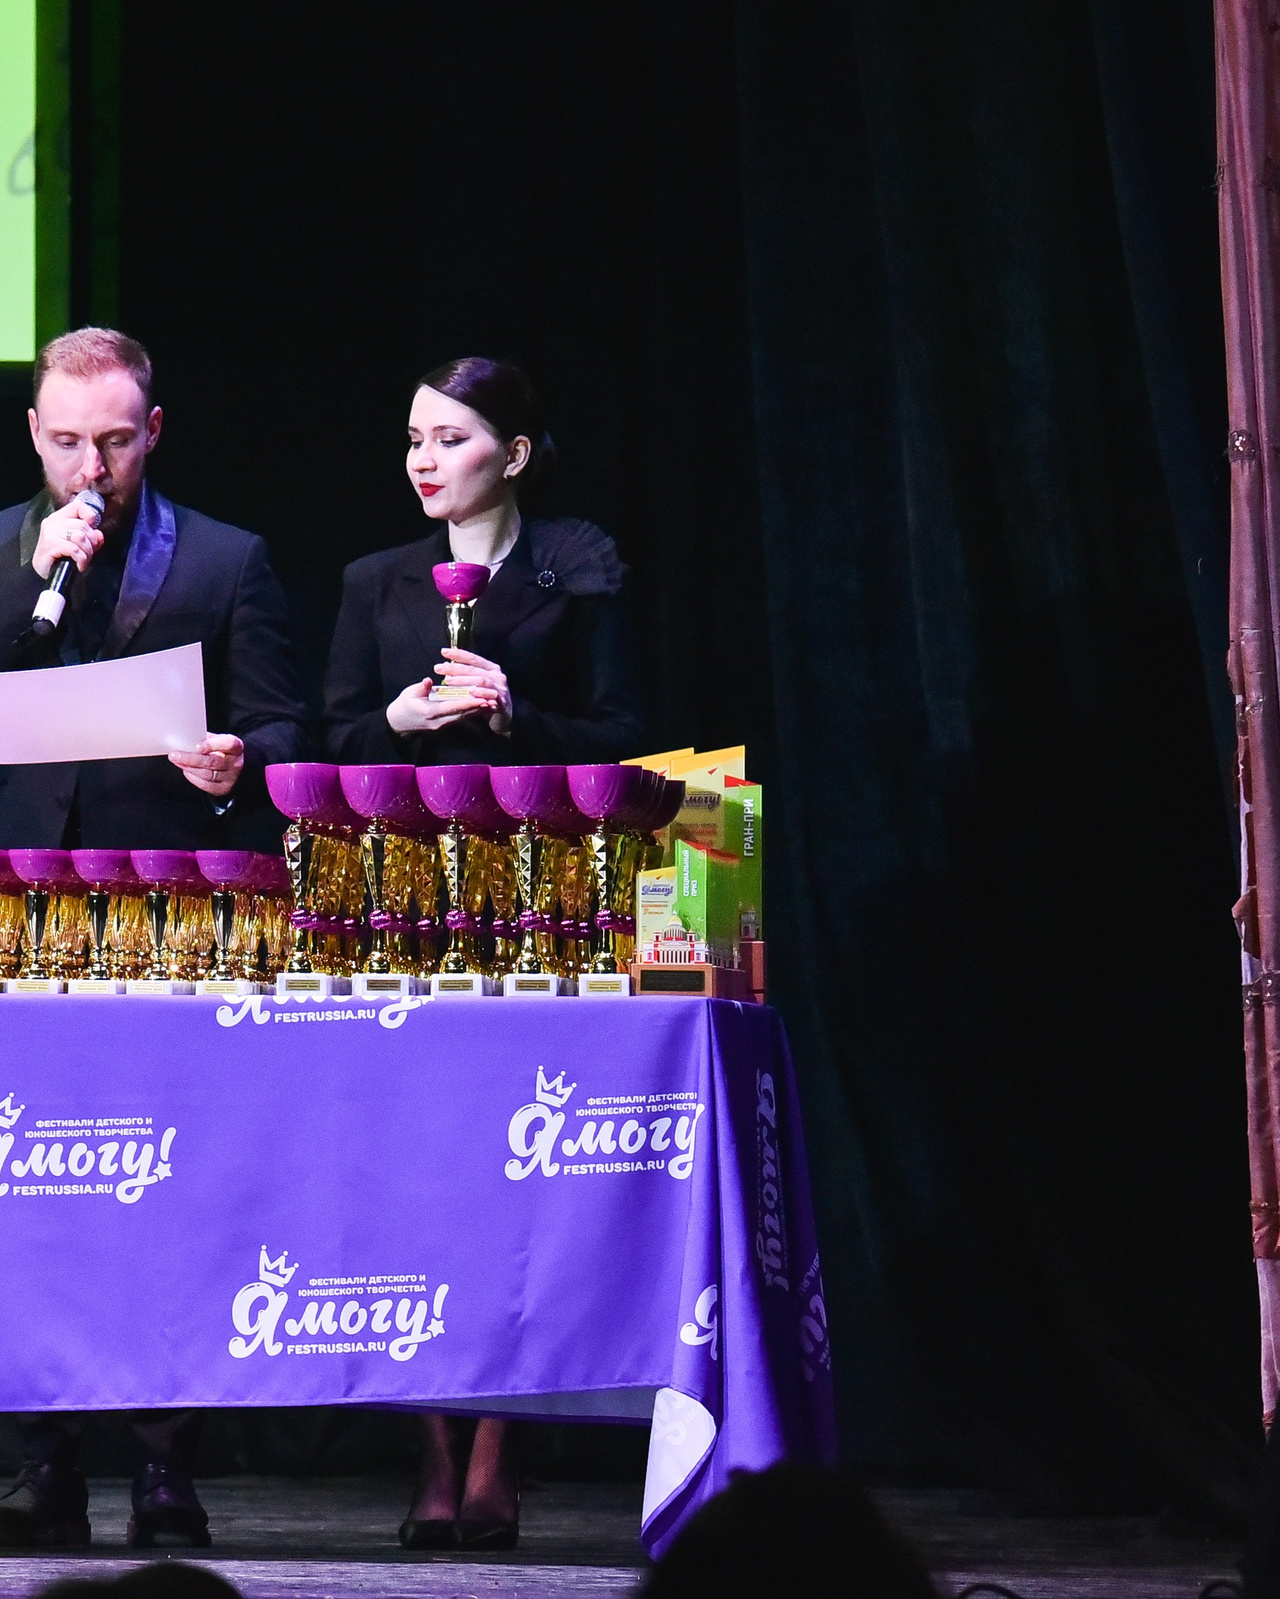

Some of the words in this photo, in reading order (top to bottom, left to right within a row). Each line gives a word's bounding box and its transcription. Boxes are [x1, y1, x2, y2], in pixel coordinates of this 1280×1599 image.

[744, 798, 754, 857] ГРАН-ПРИ
[274, 1008, 376, 1023] FESTRUSSIA.RU
[586, 1095, 646, 1106] ФЕСТИВАЛИ
[575, 1106, 644, 1117] ЮНОШЕСКОГО
[35, 1118, 94, 1128] ФЕСТИВАЛИ
[95, 1117, 144, 1128] ДЕТСКОГО
[145, 1117, 153, 1126] И
[24, 1129, 92, 1139] ЮНОШЕСКОГО
[93, 1127, 154, 1137] ТВОРЧЕСТВА
[504, 1102, 566, 1181] Я
[10, 1127, 177, 1204] могу!
[563, 1159, 665, 1176] FESTRUSSIA.RU
[13, 1183, 114, 1196] FESTRUSSIA.RU
[309, 1275, 367, 1286] ФЕСТИВАЛИ
[368, 1274, 417, 1285] ДЕТСКОГО
[418, 1274, 426, 1283] И
[298, 1286, 365, 1297] ЮНОШЕСКОГО
[366, 1284, 427, 1295] ТВОРЧЕСТВА
[228, 1281, 289, 1359] Я
[284, 1283, 450, 1362] могу!
[286, 1341, 387, 1355] FESTRUSSIA.RU
